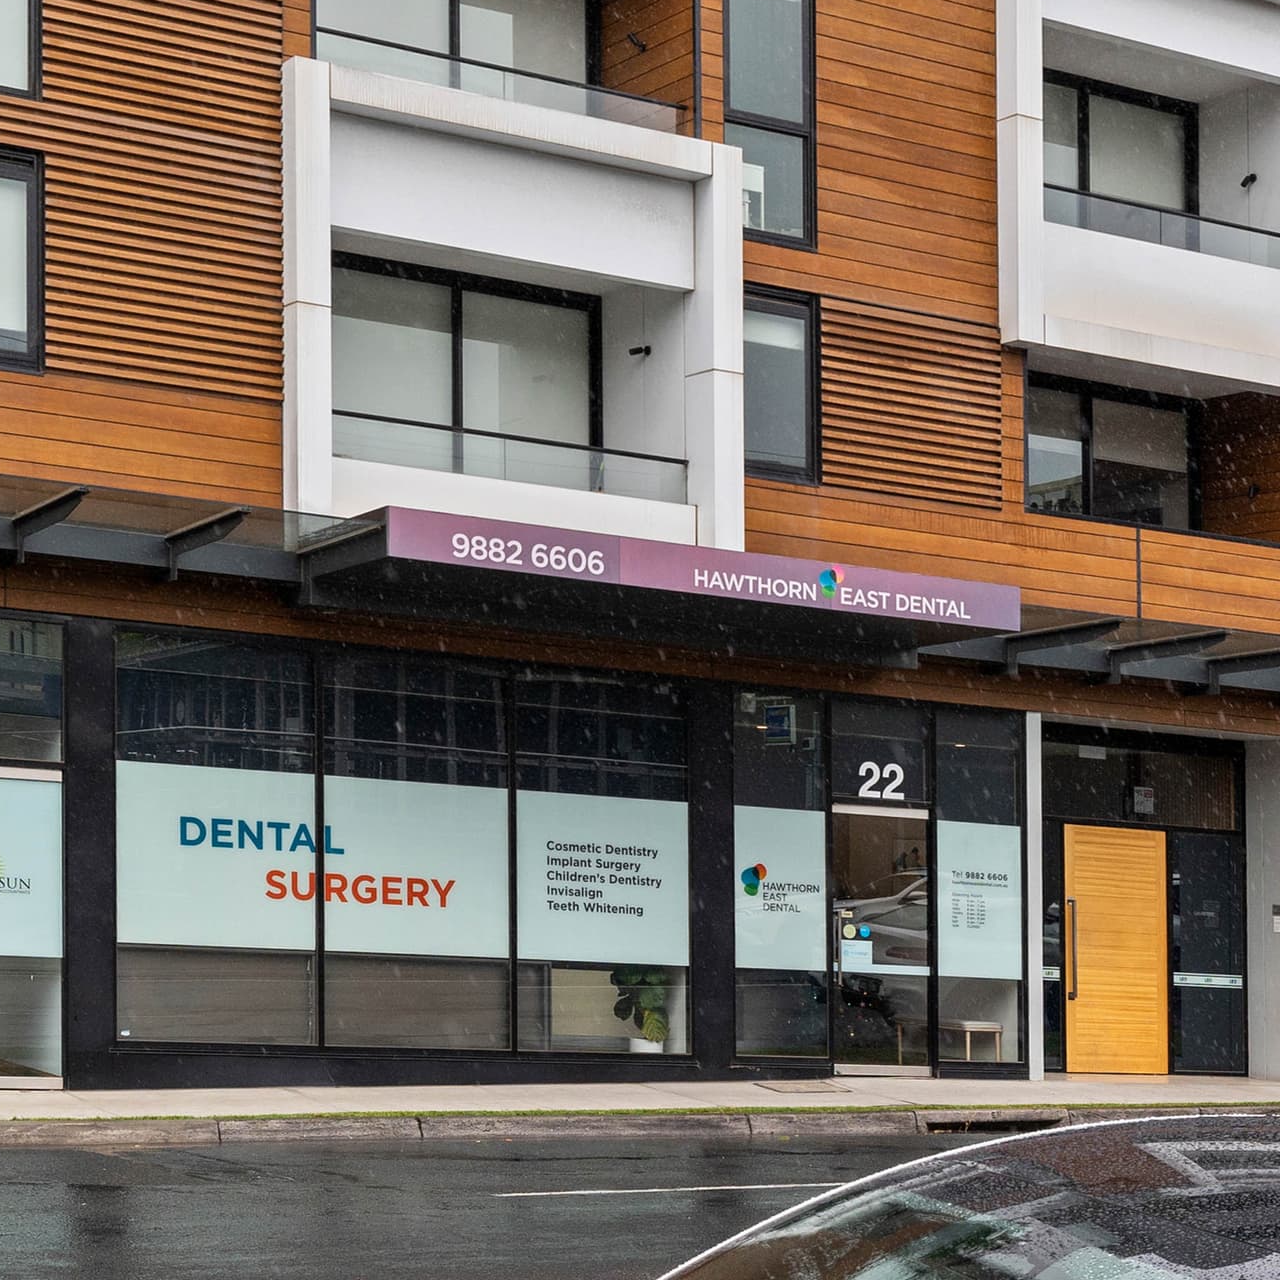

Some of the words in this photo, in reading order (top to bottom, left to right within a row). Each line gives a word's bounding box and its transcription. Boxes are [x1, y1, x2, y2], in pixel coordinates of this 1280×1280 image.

[451, 532, 523, 566] 9882
[530, 542, 605, 576] 6606
[693, 568, 817, 603] HAWTHORN
[839, 586, 891, 611] EAST
[895, 593, 971, 620] DENTAL
[857, 760, 906, 800] 22
[179, 815, 345, 855] DENTAL
[546, 839, 603, 856] Cosmetic
[605, 843, 659, 860] Dentistry
[546, 856, 592, 871] Implant
[595, 858, 641, 874] Surgery
[546, 870, 606, 885] Children's
[608, 874, 663, 890] Dentistry
[951, 870, 963, 879] Tel
[965, 871, 985, 880] 9882
[987, 873, 1008, 882] 6606
[264, 869, 456, 909] SURGERY
[546, 885, 604, 900] Invisalign
[762, 882, 820, 894] HAWTHORN
[762, 892, 788, 903] EAST
[546, 900, 580, 914] Teeth
[583, 902, 644, 917] Whitening
[762, 903, 800, 913] DENTAL
